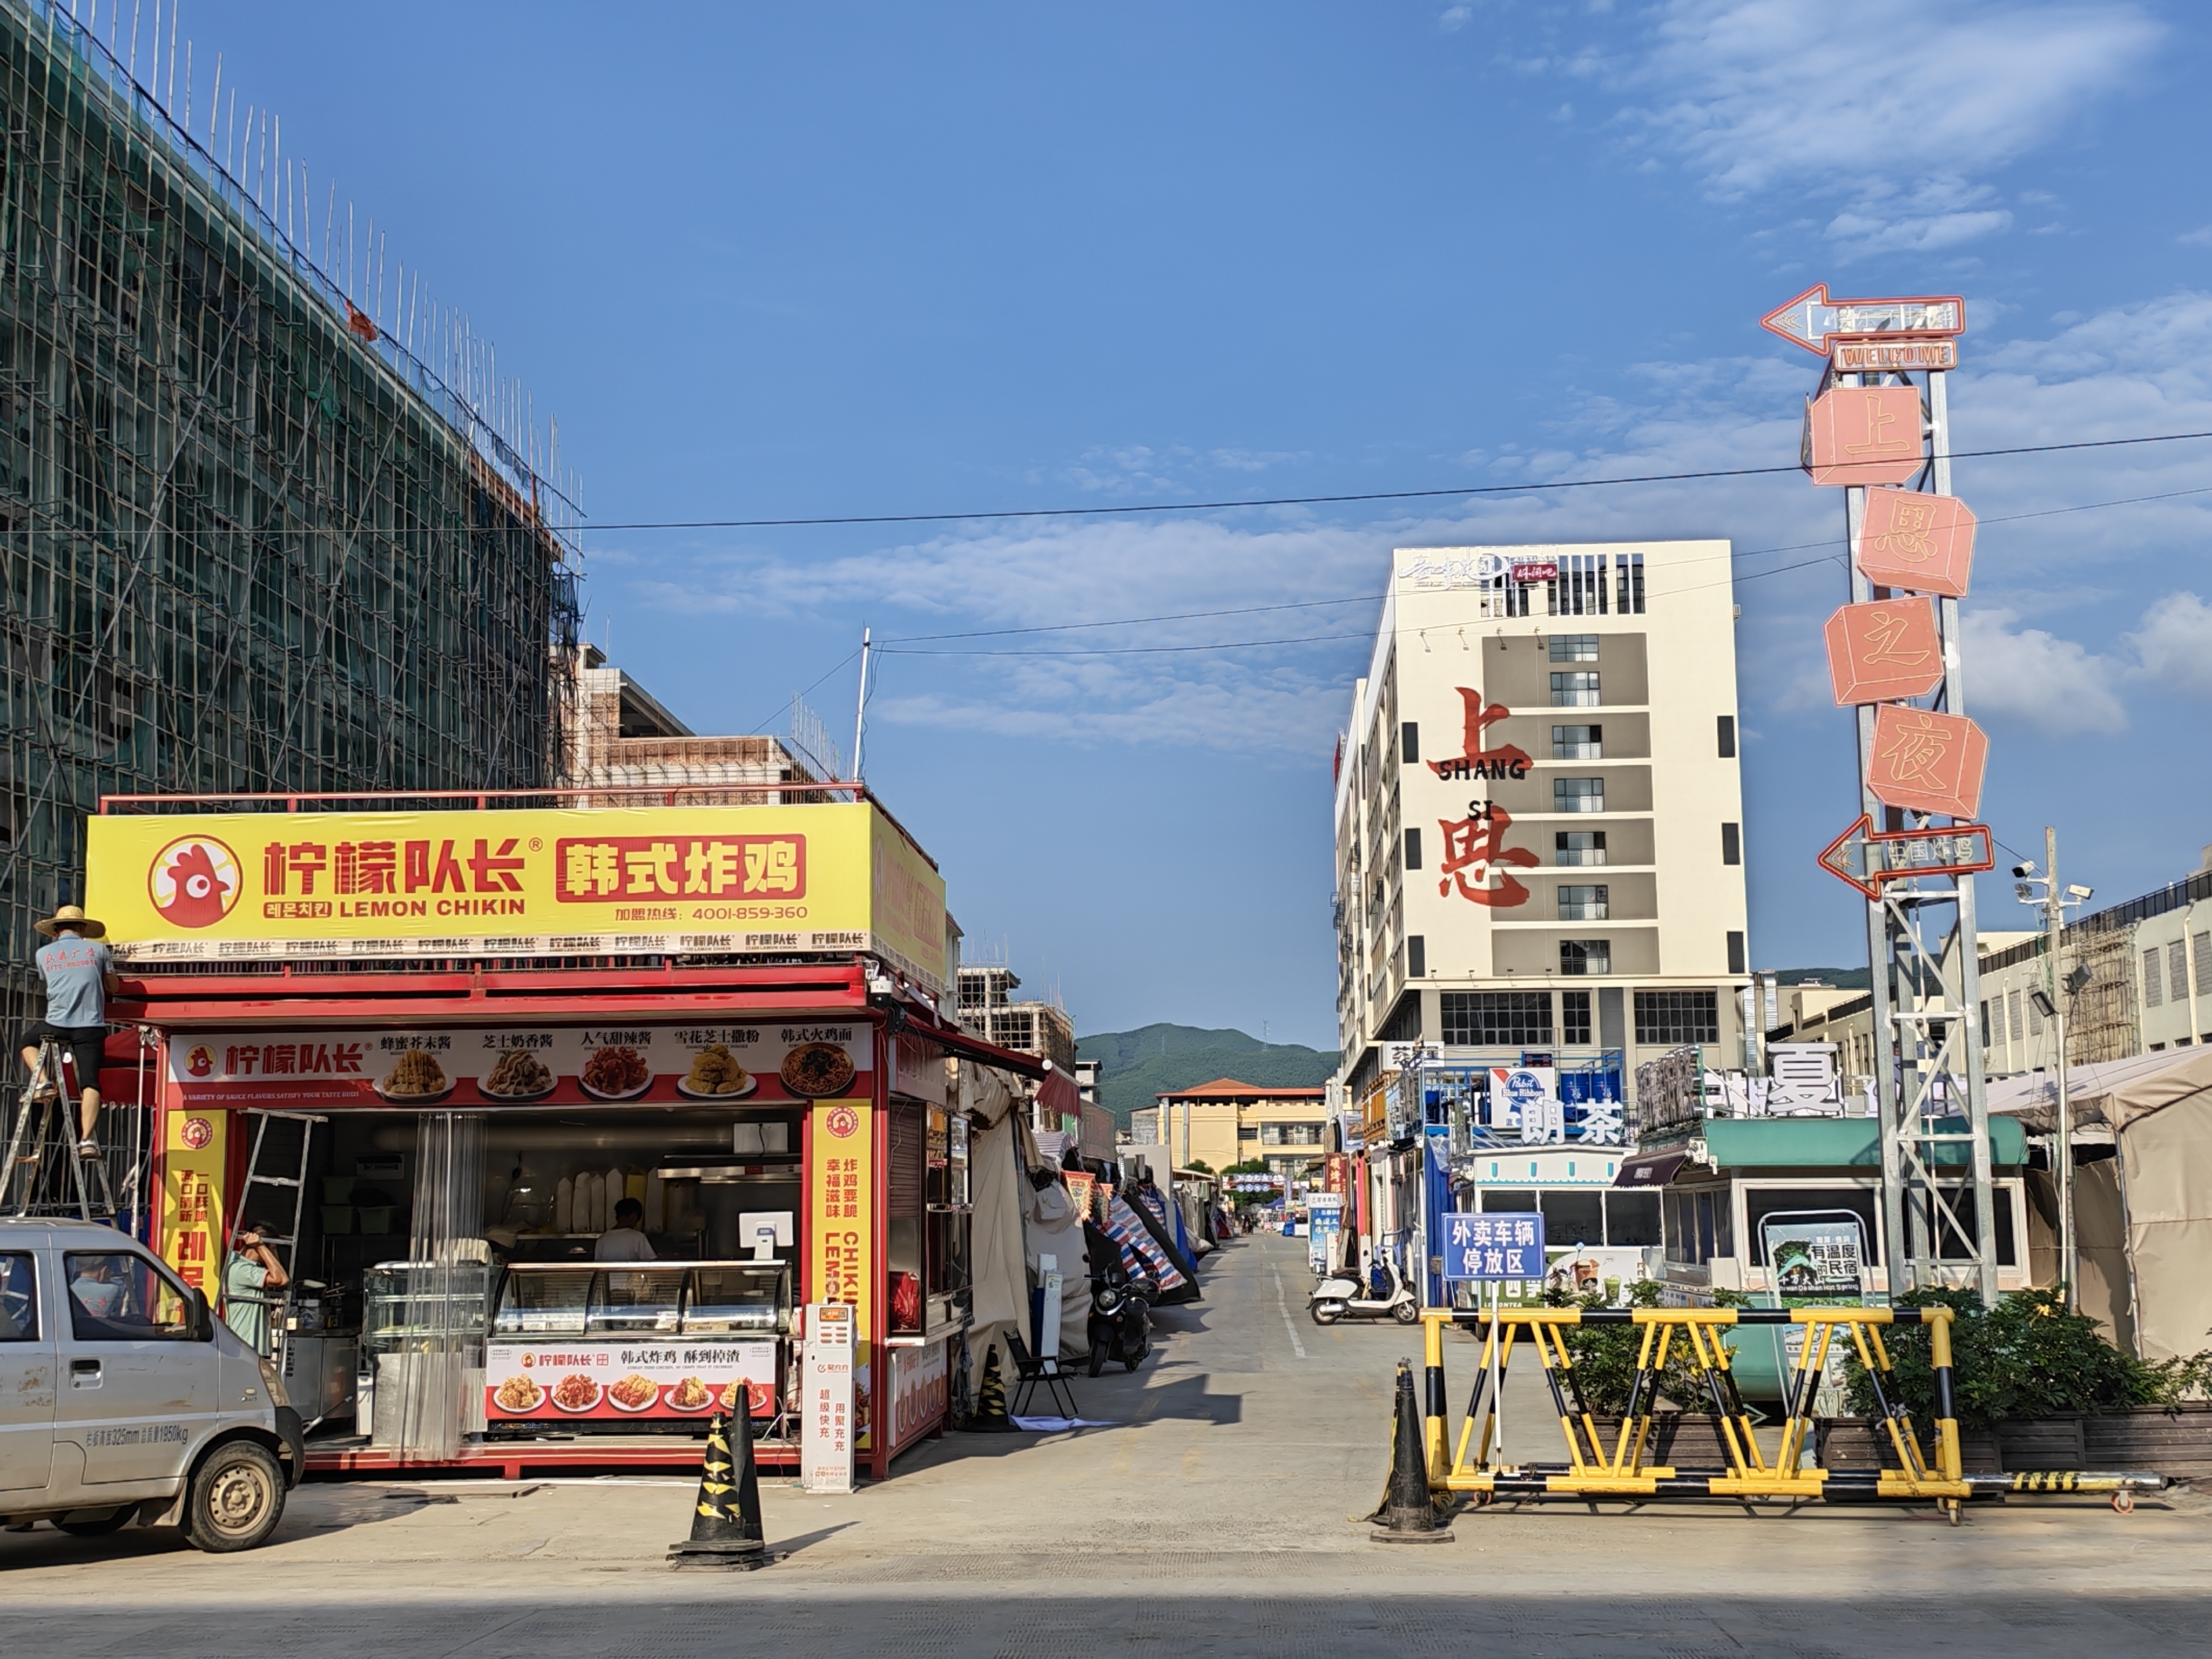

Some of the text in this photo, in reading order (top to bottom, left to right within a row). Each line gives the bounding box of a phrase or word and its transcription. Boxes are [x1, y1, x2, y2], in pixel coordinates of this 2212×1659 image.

[1843, 346, 1947, 364] WELCOME
[1426, 687, 1534, 775] 上
[1439, 759, 1526, 781] SHANG
[1467, 800, 1495, 821] SI
[264, 838, 525, 895] 柠檬队长
[1438, 805, 1540, 907] 思
[565, 840, 799, 896] 韩式炸鸡
[266, 899, 525, 918] 레몬치킨 LEMON CHIKIN
[380, 1035, 451, 1050] 蜂蜜芥末酱
[482, 1034, 554, 1049] 芝士奶香酱
[581, 1030, 652, 1046] 人气甜辣酱
[674, 1029, 760, 1044] 雪花芝士撒粉
[781, 1027, 852, 1043] 韩式火鸡面
[225, 1043, 363, 1075] 柠檬队长
[1512, 1075, 1535, 1088] Pabst
[1767, 1042, 1842, 1112] 夏
[1519, 1088, 1543, 1096] Ribbon
[1521, 1098, 1623, 1145] 朗茶
[826, 1158, 840, 1218] 幸福滋味
[843, 1158, 858, 1218] 炸鸡要脆
[1452, 1219, 1535, 1247] 外卖车辆
[1463, 1248, 1525, 1275] 停放区
[1811, 1244, 1857, 1259] 有温度
[1817, 1260, 1858, 1275] 的民宿
[1779, 1274, 1825, 1285] 十万大山
[539, 1354, 592, 1366] 柠檬队长
[621, 1350, 677, 1364] 韩式炸鸡
[684, 1349, 740, 1364] 酥到掉渣
[819, 1388, 831, 1439] 超级快充
[834, 1403, 845, 1452] 用聚充充
